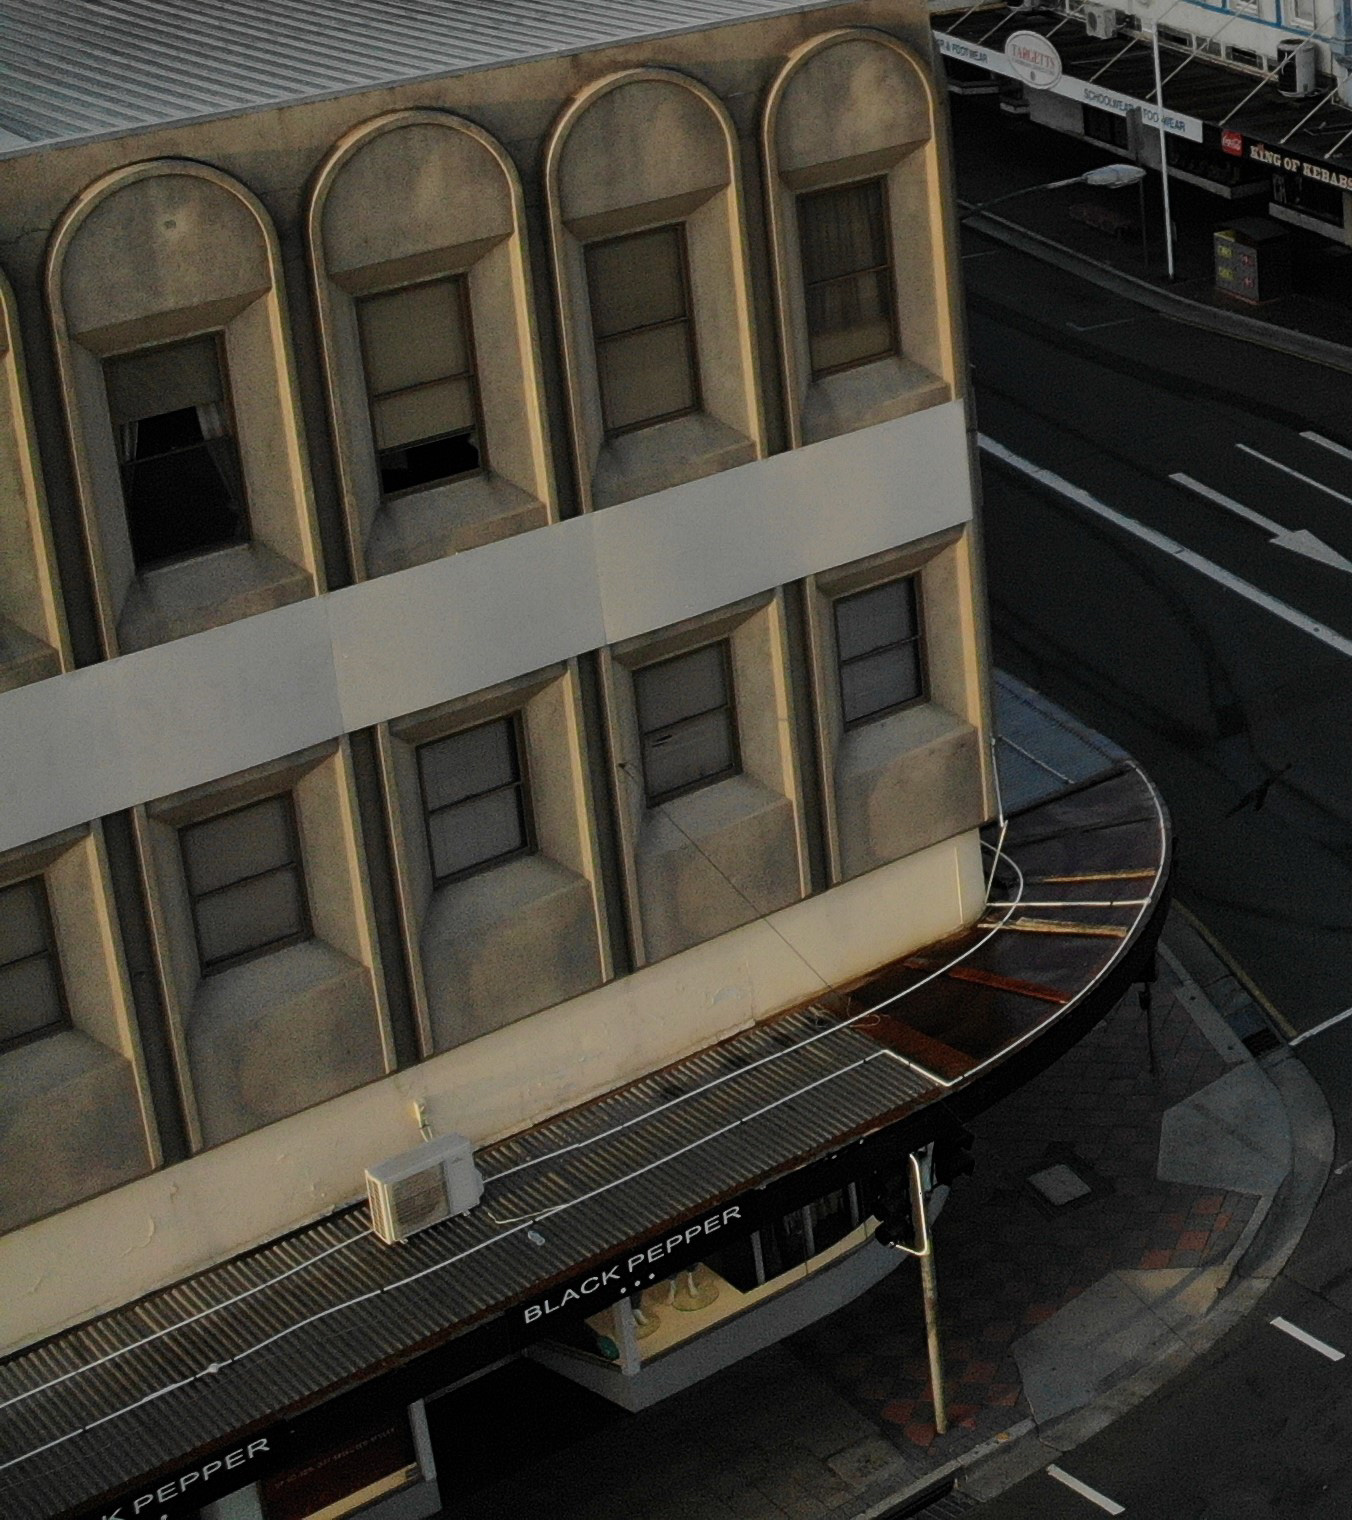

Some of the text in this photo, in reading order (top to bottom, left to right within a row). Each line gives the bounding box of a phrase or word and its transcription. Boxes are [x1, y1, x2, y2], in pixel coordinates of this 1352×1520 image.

[1012, 43, 1056, 69] TARGETTS
[1143, 106, 1186, 131] FOOWEAR
[1250, 145, 1281, 169] KING
[1283, 157, 1299, 173] OF
[524, 1205, 742, 1324] BLACK PEPPER
[132, 1437, 271, 1516] PEPPER
